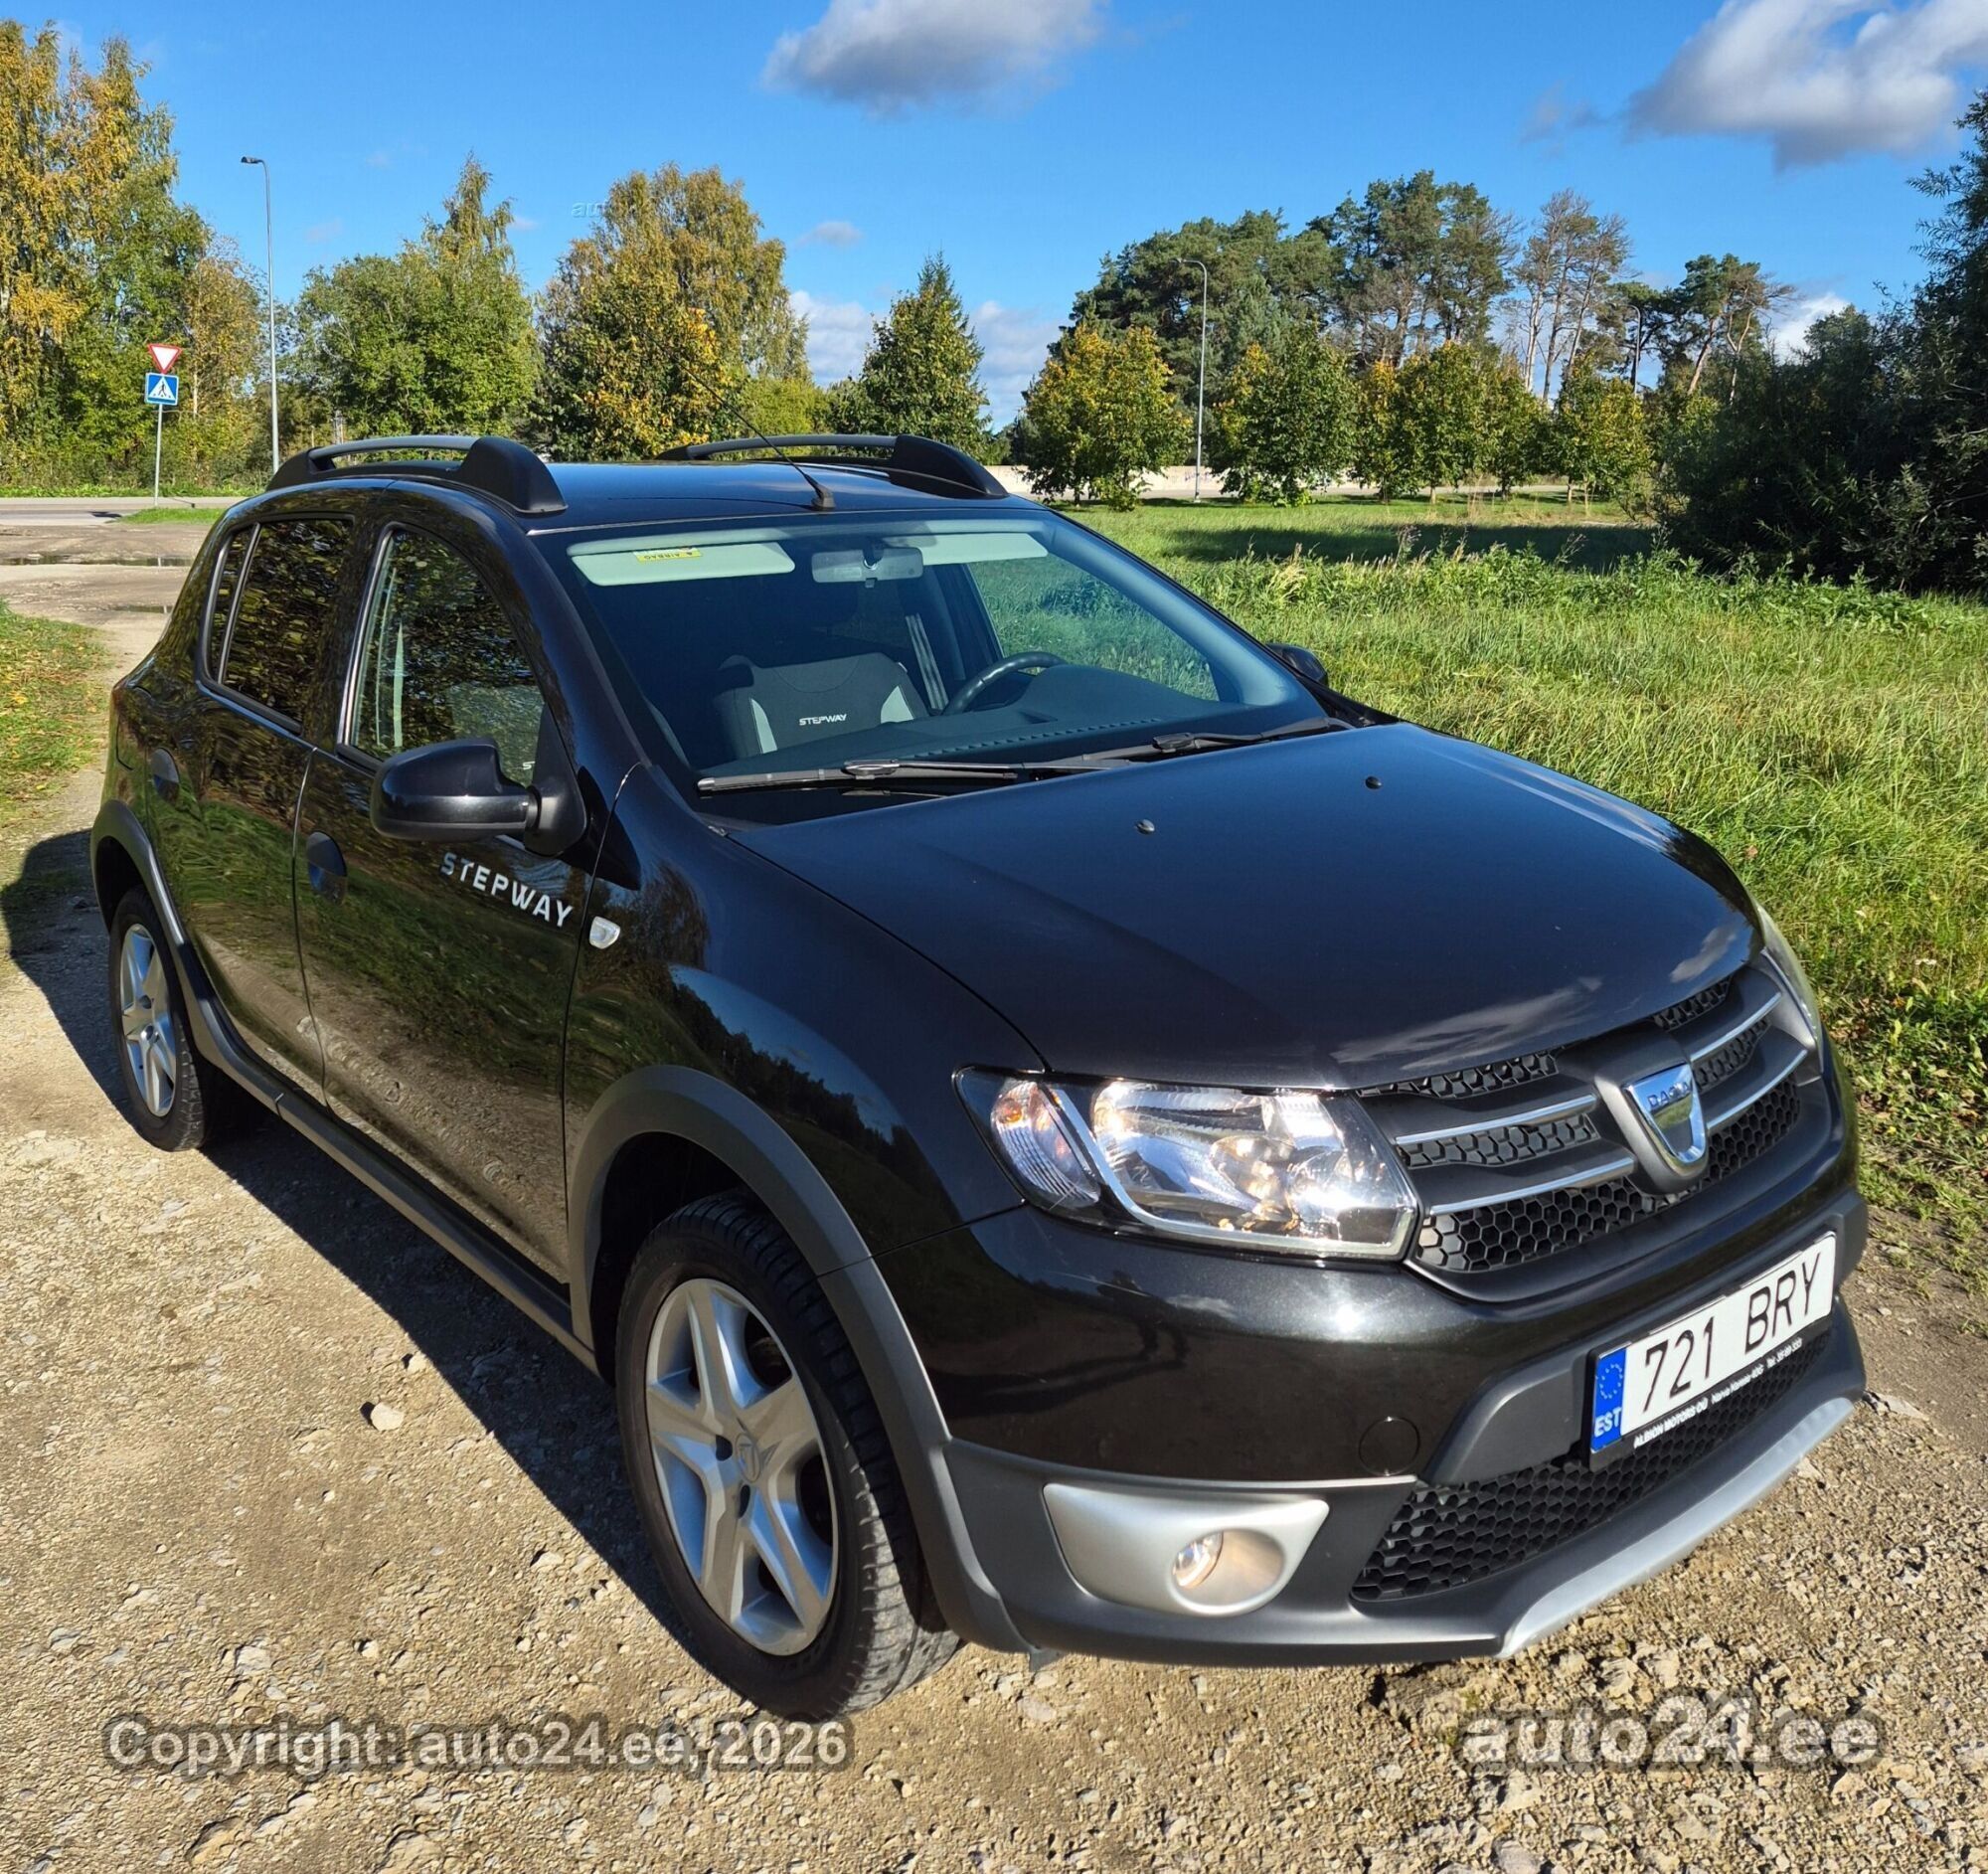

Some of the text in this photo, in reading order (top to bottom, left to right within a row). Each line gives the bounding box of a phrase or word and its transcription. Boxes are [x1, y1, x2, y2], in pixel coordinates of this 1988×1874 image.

[798, 713, 847, 726] STEPWAY
[439, 851, 574, 928] STEPWAY
[1643, 1316, 1715, 1413] 721
[1744, 1252, 1821, 1355] BRY
[1593, 1406, 1622, 1438] EST
